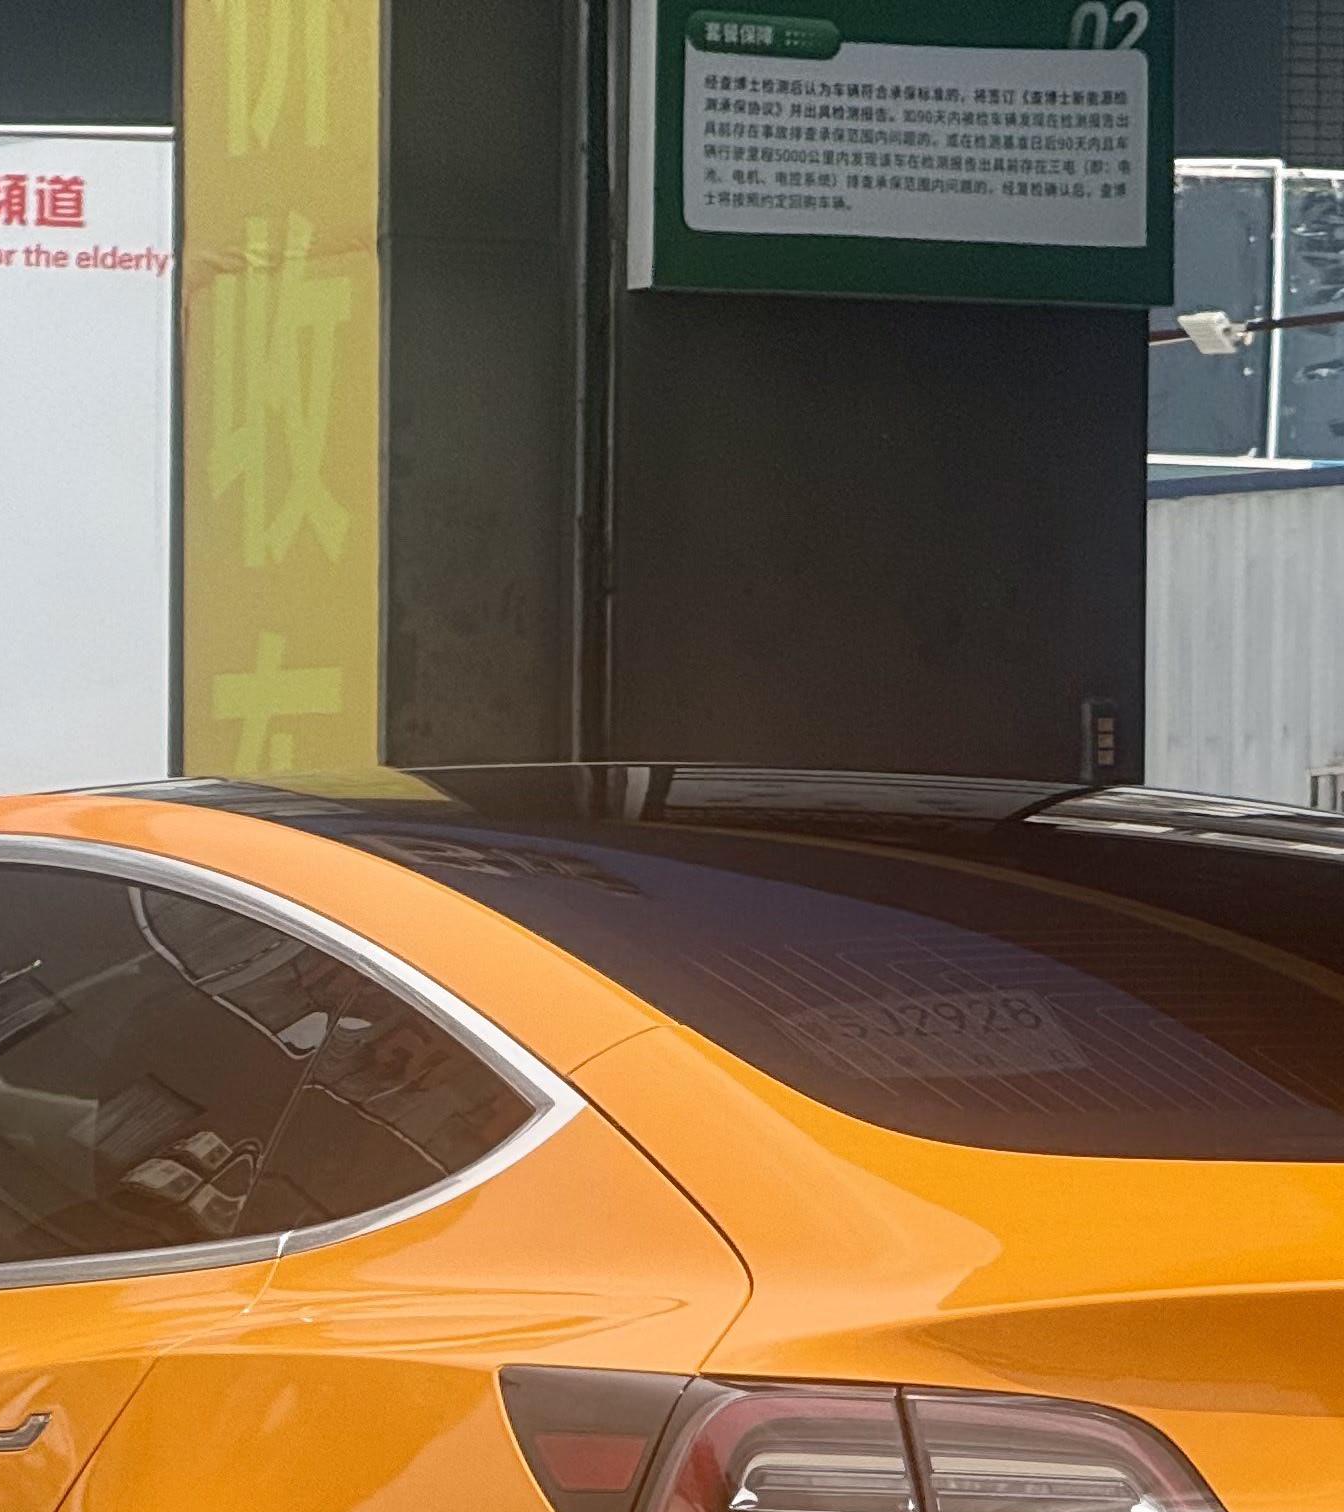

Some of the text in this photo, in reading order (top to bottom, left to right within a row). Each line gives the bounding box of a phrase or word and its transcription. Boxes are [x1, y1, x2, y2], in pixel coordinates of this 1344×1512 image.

[1069, 0, 1149, 50] 02
[24, 243, 68, 269] the
[75, 245, 170, 277] elderly
